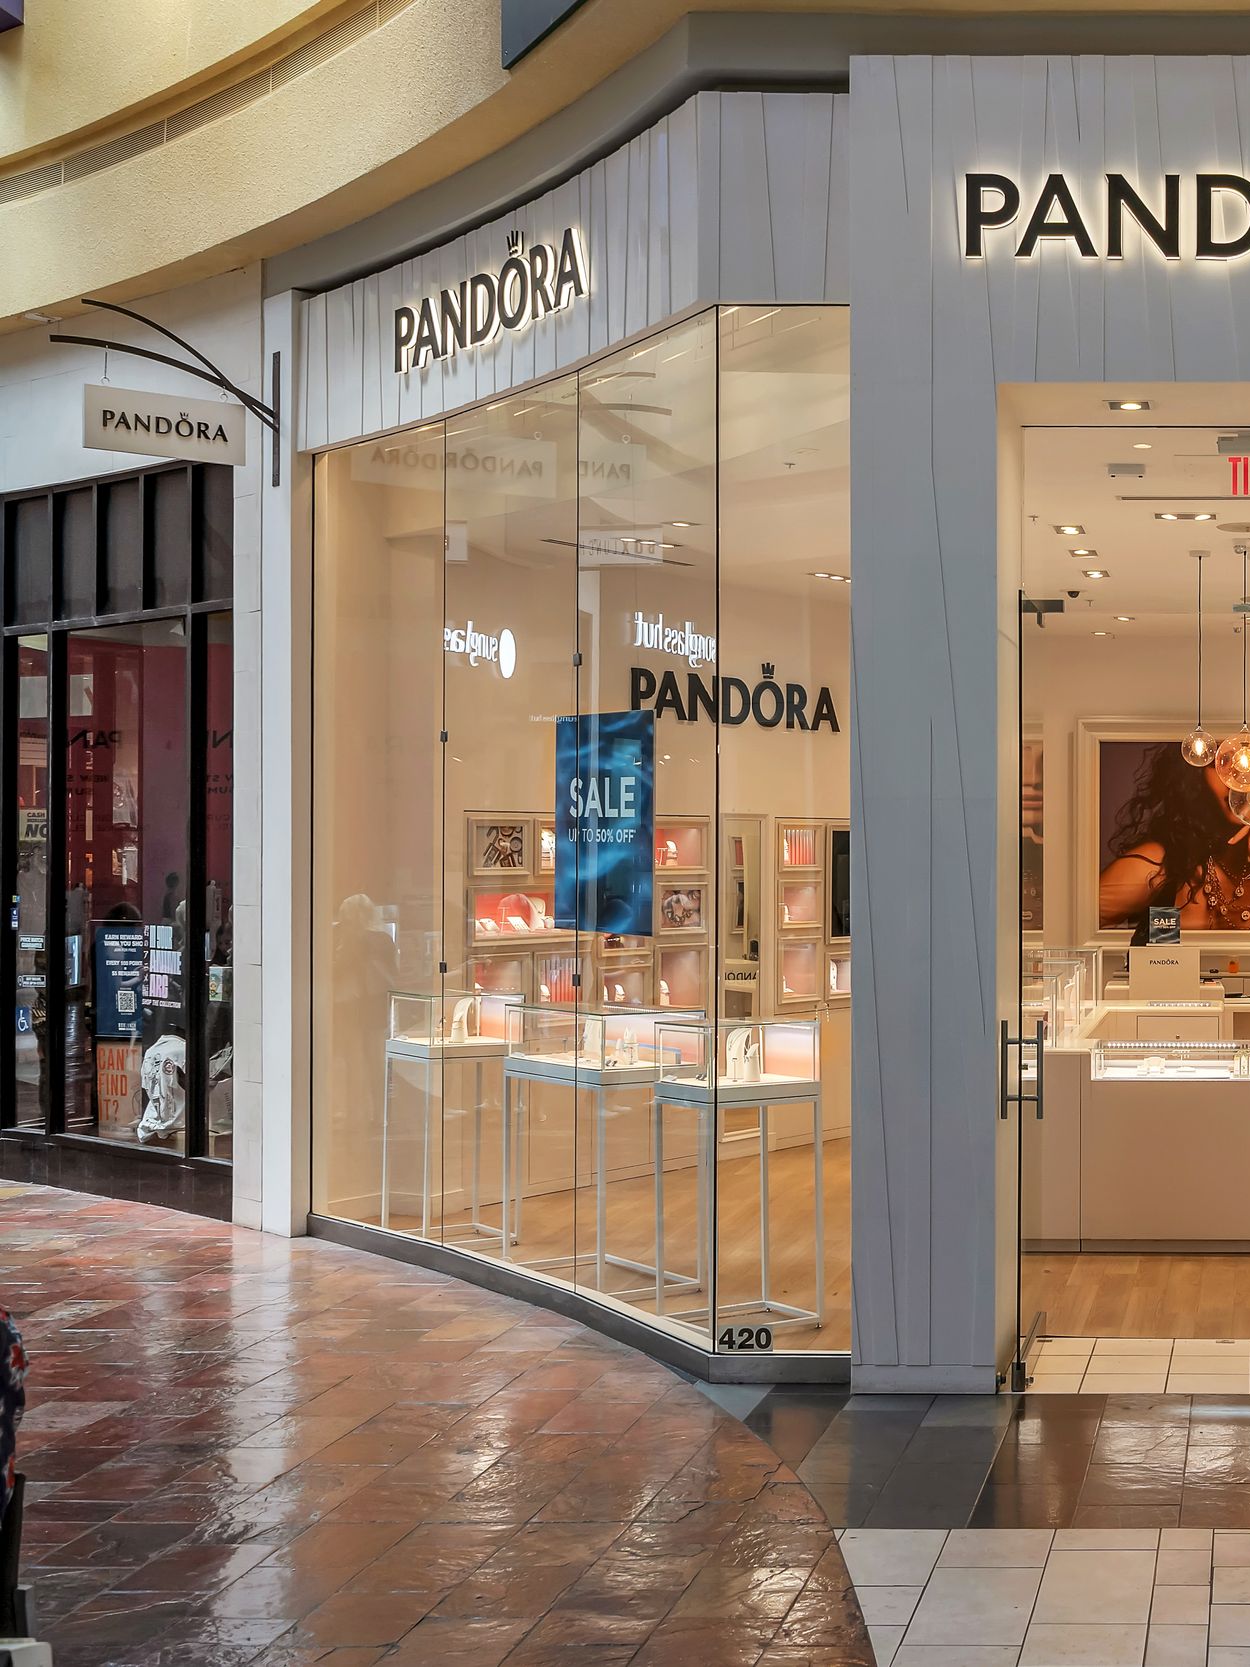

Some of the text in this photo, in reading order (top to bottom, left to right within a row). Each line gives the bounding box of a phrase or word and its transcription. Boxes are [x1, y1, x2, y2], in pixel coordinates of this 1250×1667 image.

[394, 227, 588, 373] PANDORA
[102, 408, 229, 444] PANDORA
[630, 667, 840, 733] PANDORA
[569, 777, 636, 818] SALE
[582, 828, 594, 842] TO
[596, 828, 614, 843] 50%
[97, 1048, 138, 1071] CAN'T
[97, 1075, 128, 1097] FIND
[98, 1100, 119, 1121] IT?
[719, 1328, 772, 1349] 420
